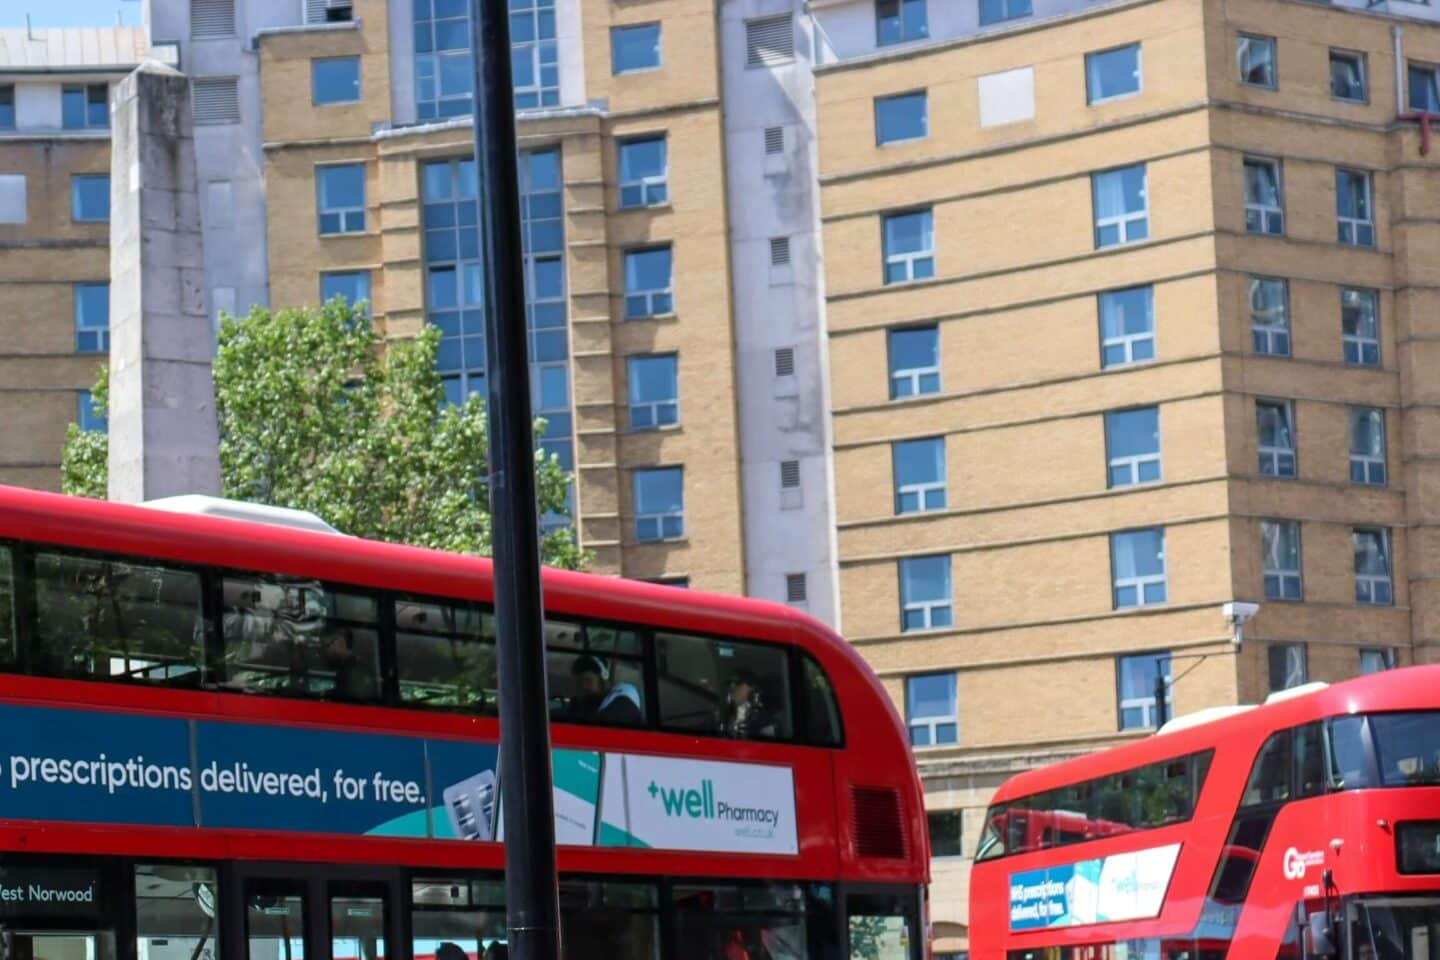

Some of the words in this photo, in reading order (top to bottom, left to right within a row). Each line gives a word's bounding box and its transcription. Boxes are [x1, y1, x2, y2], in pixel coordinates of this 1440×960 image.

[10, 753, 192, 794] prescriptions
[201, 761, 327, 803] delivered,
[333, 769, 367, 800] for
[372, 771, 425, 803] free.
[717, 802, 779, 827] Pharmacy
[28, 884, 93, 902] Norwood
